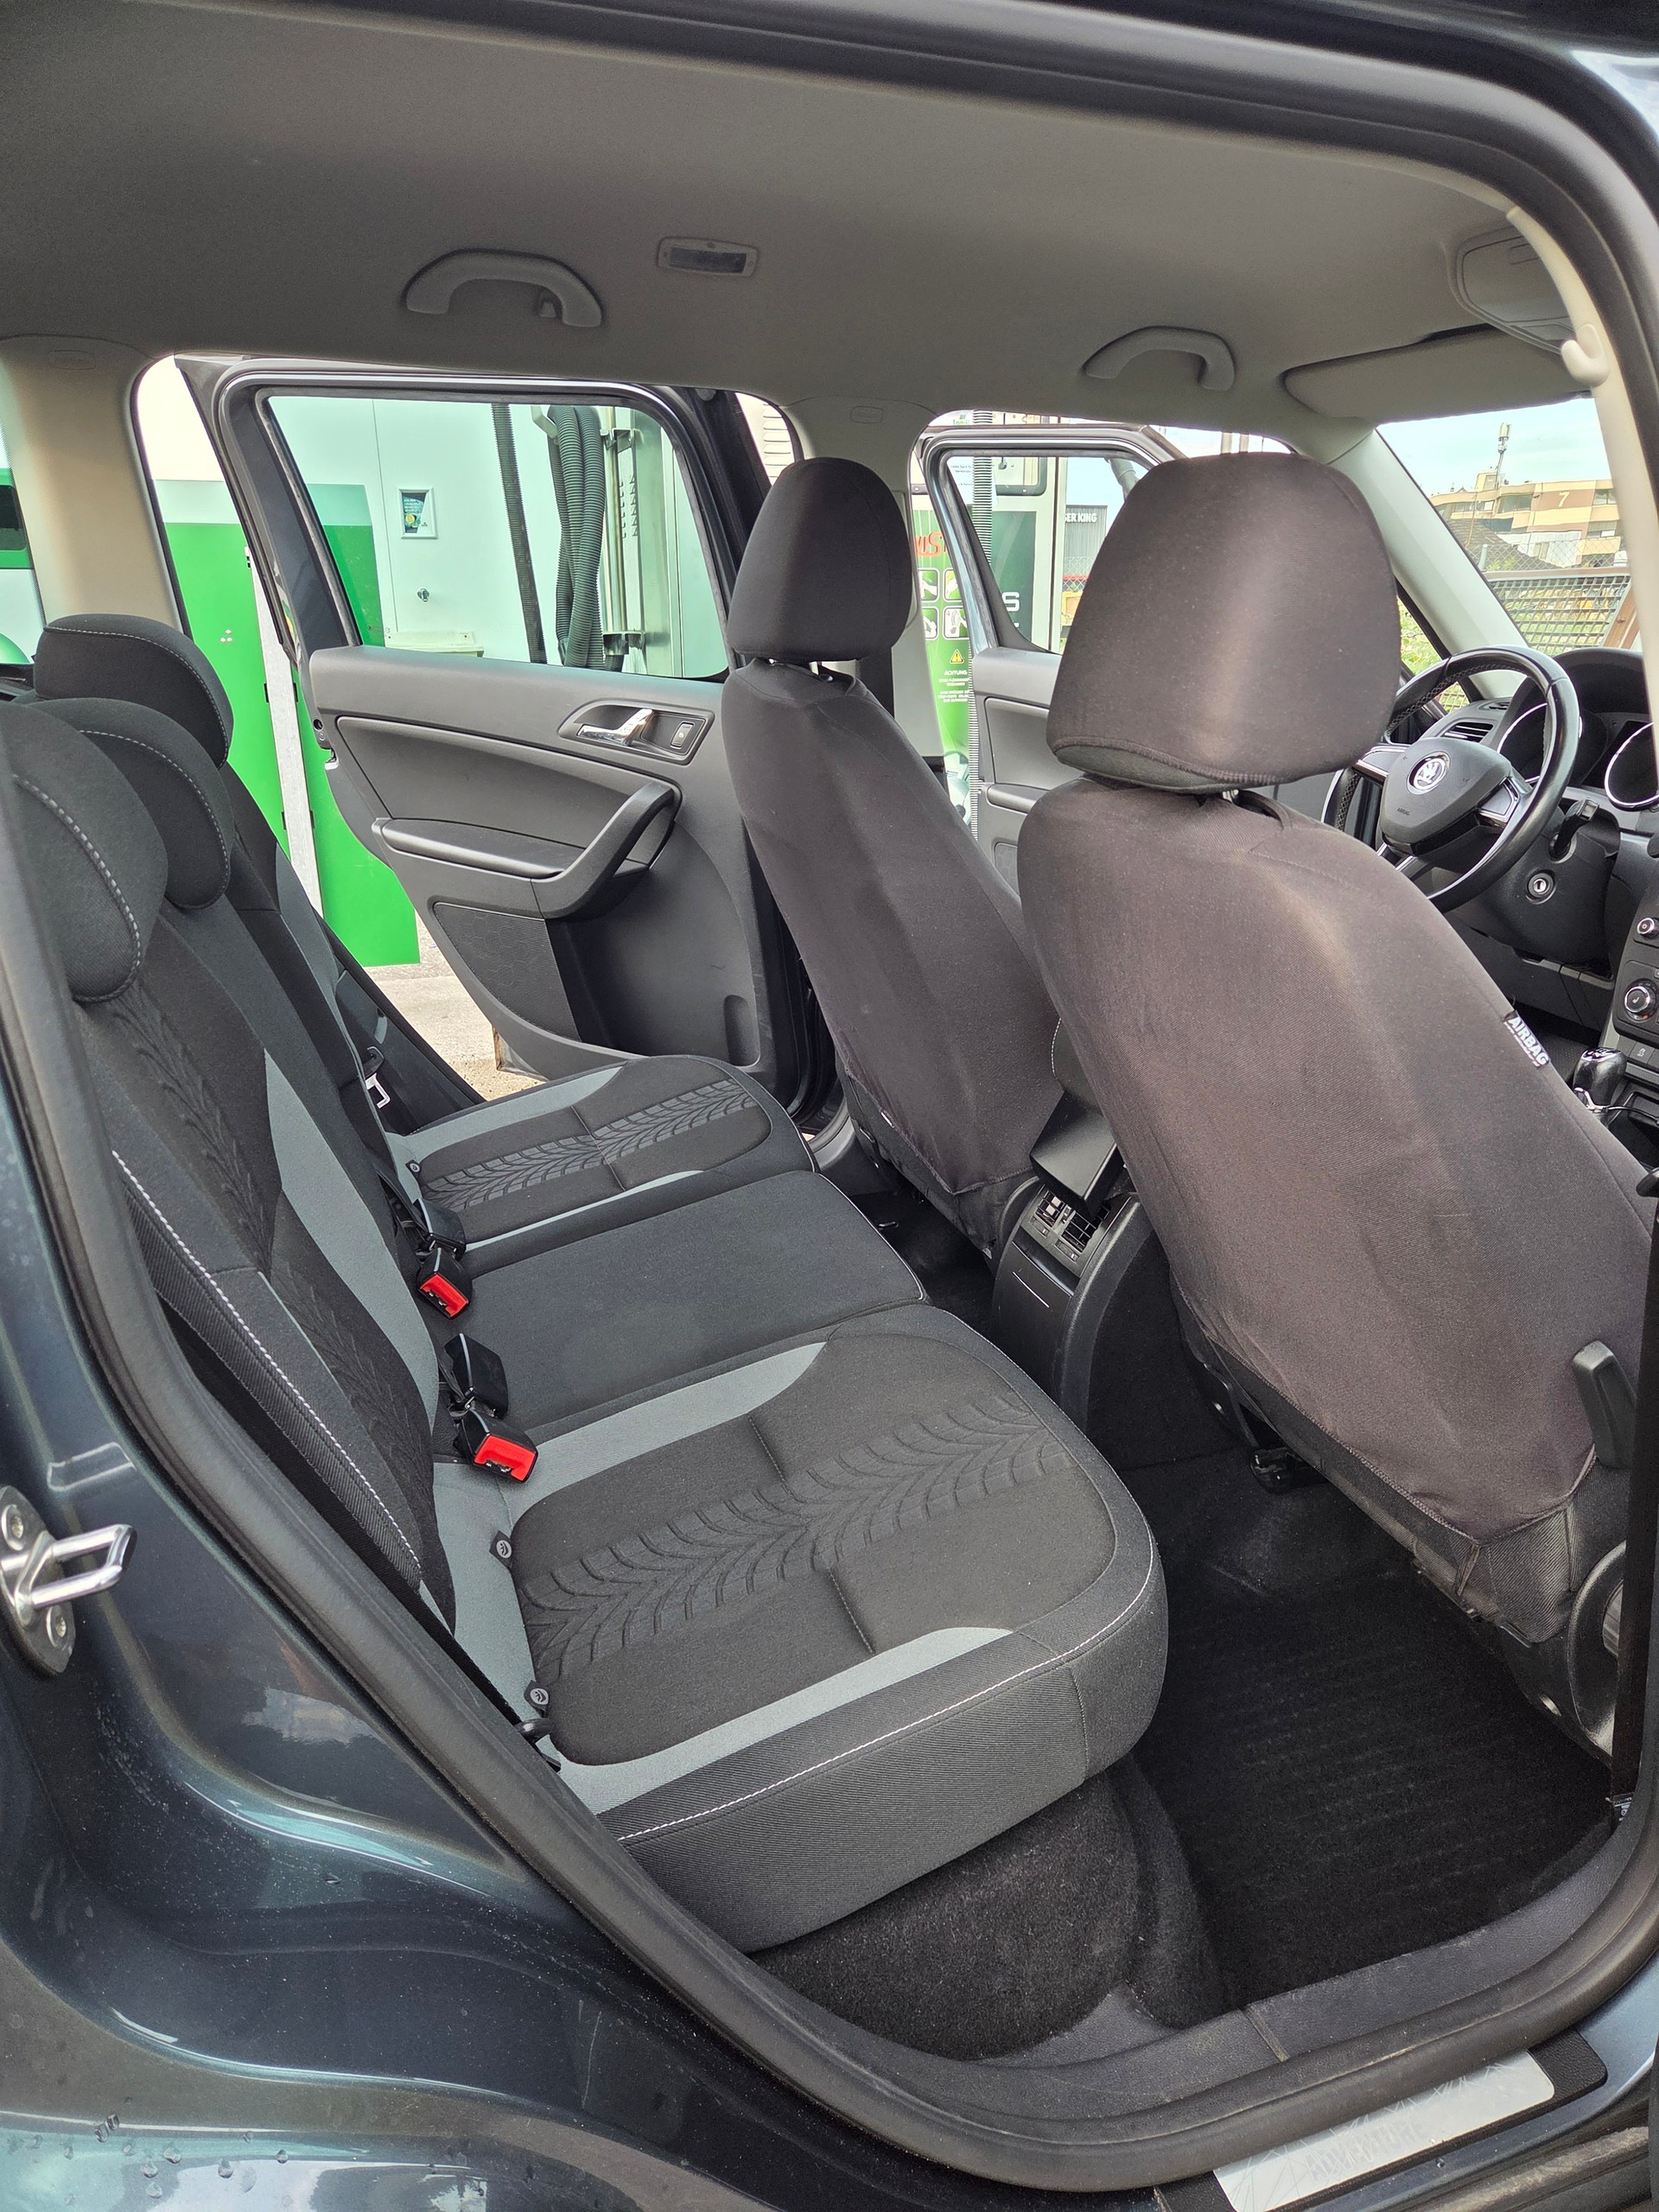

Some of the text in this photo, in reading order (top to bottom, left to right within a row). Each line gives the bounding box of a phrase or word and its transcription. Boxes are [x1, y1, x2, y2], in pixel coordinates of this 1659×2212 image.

[1559, 491, 1570, 507] 7
[1077, 512, 1097, 523] KING
[1506, 1017, 1549, 1065] AIRBAG
